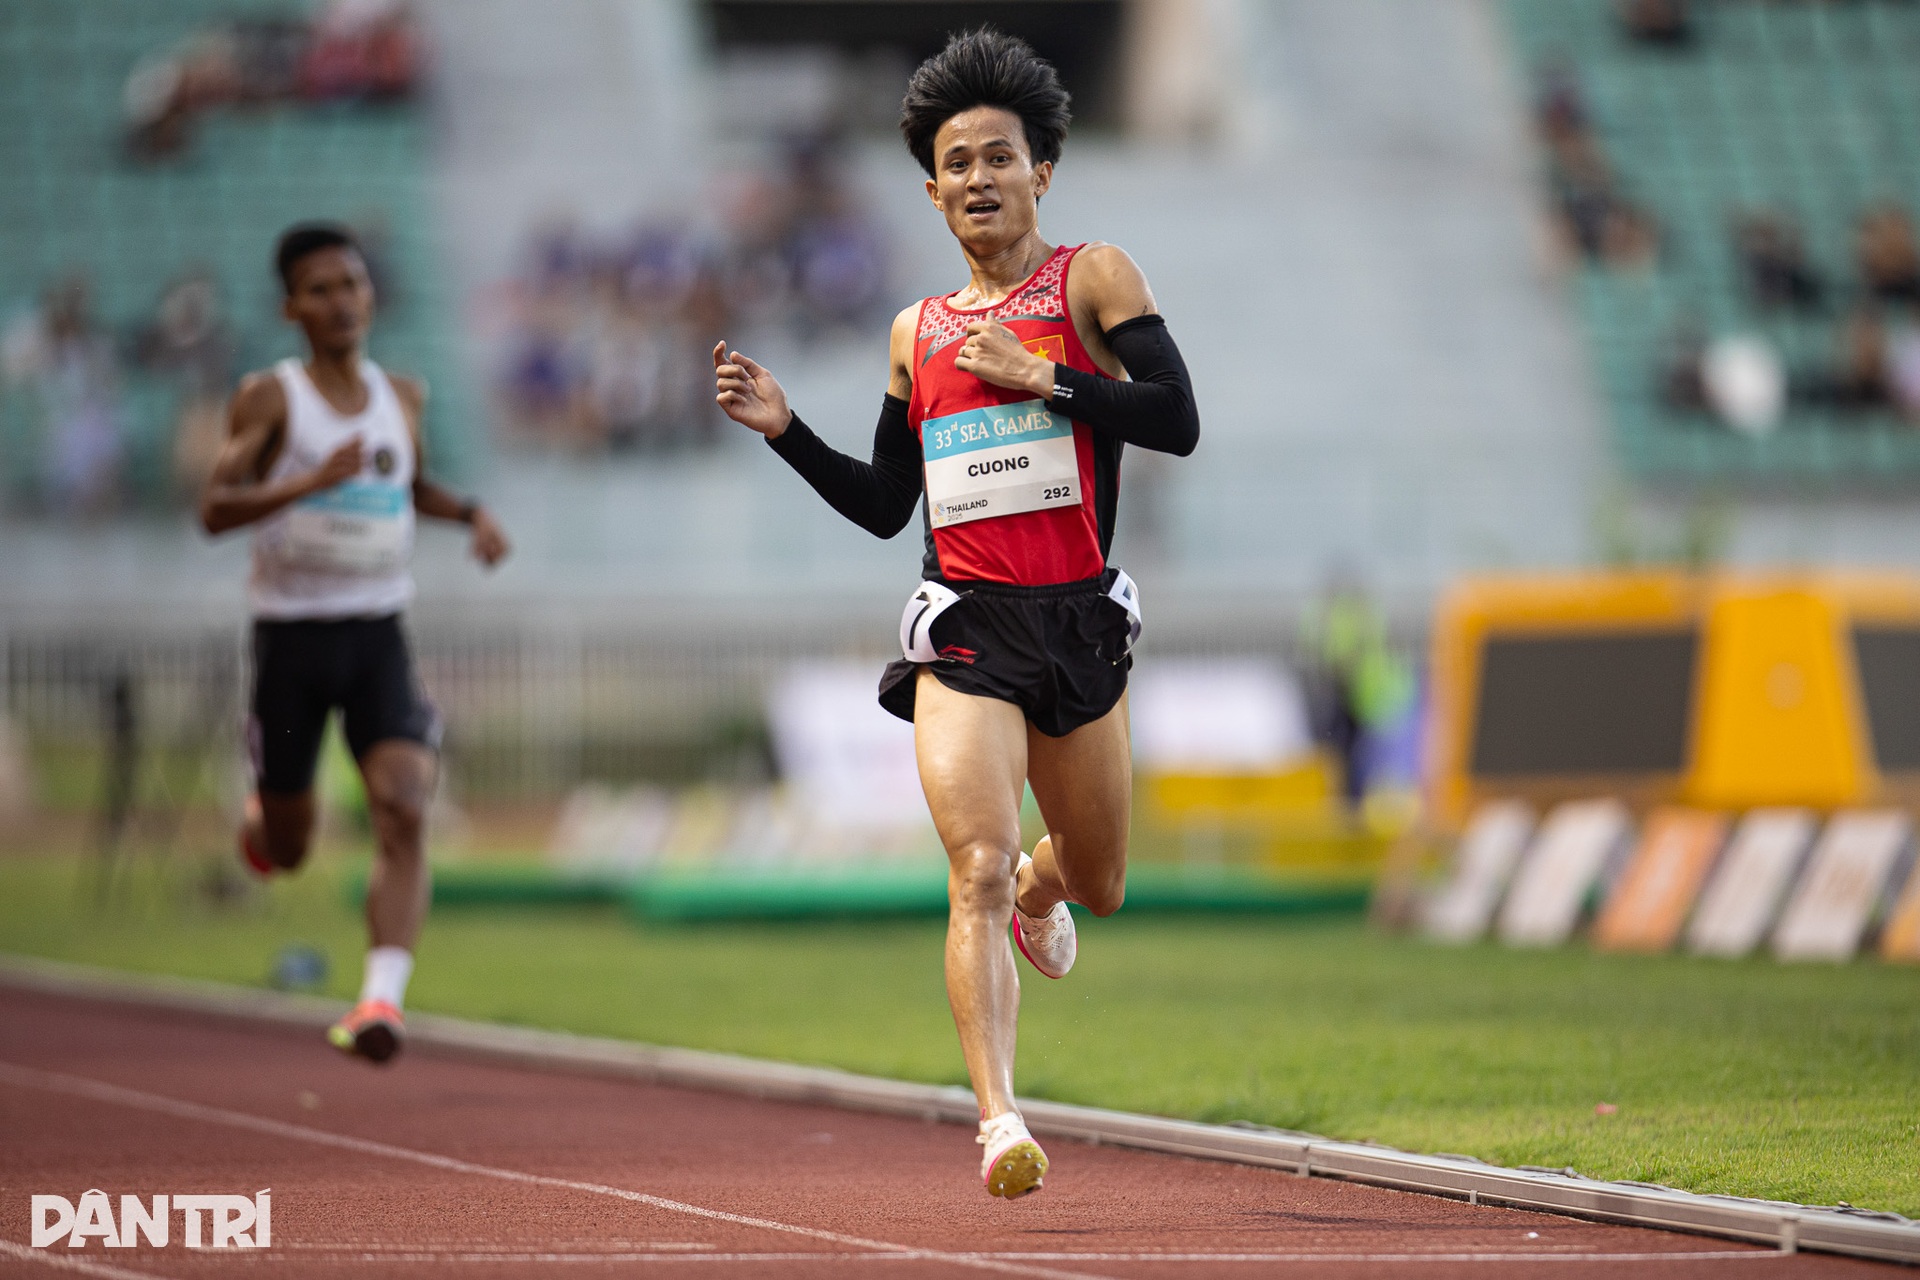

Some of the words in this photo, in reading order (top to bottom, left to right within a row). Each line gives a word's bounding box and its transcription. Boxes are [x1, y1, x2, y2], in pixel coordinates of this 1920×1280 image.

[960, 425, 990, 444] SEA
[993, 410, 1053, 437] GAMES
[967, 455, 1030, 478] CUONG
[1043, 486, 1071, 500] 292
[946, 499, 988, 514] THAILAND
